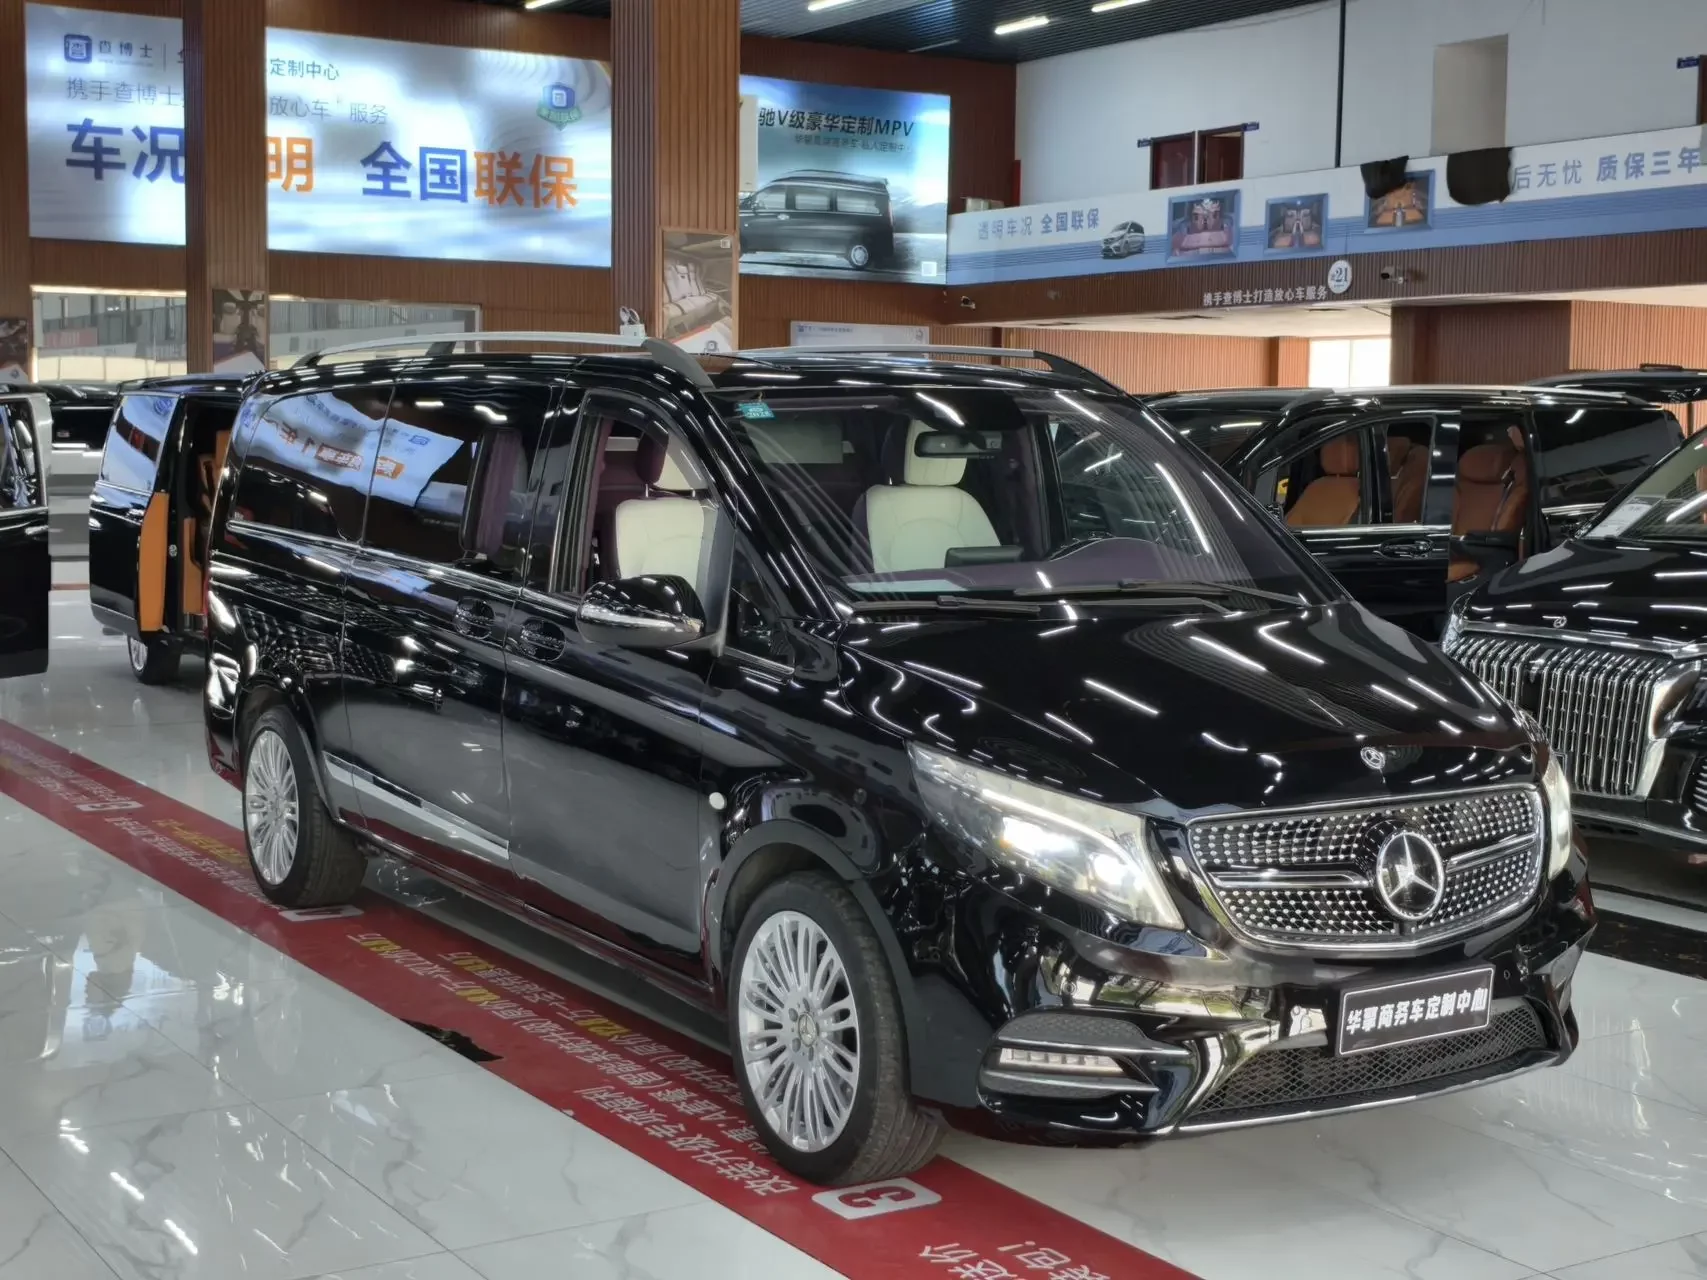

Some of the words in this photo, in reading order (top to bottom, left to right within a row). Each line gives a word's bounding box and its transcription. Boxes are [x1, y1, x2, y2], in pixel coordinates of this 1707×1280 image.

[269, 58, 340, 81] 定制中心
[65, 117, 186, 184] 车况
[267, 136, 315, 193] 明
[360, 140, 579, 210] 全国联保
[1596, 146, 1700, 183] 质保三年
[978, 215, 1033, 241] 透明车况
[1040, 207, 1100, 234] 全国联保
[1203, 285, 1328, 307] 携手查博士打造放心车服务
[574, 1085, 800, 1196] 改装升级专项福利
[837, 1186, 917, 1210] 3
